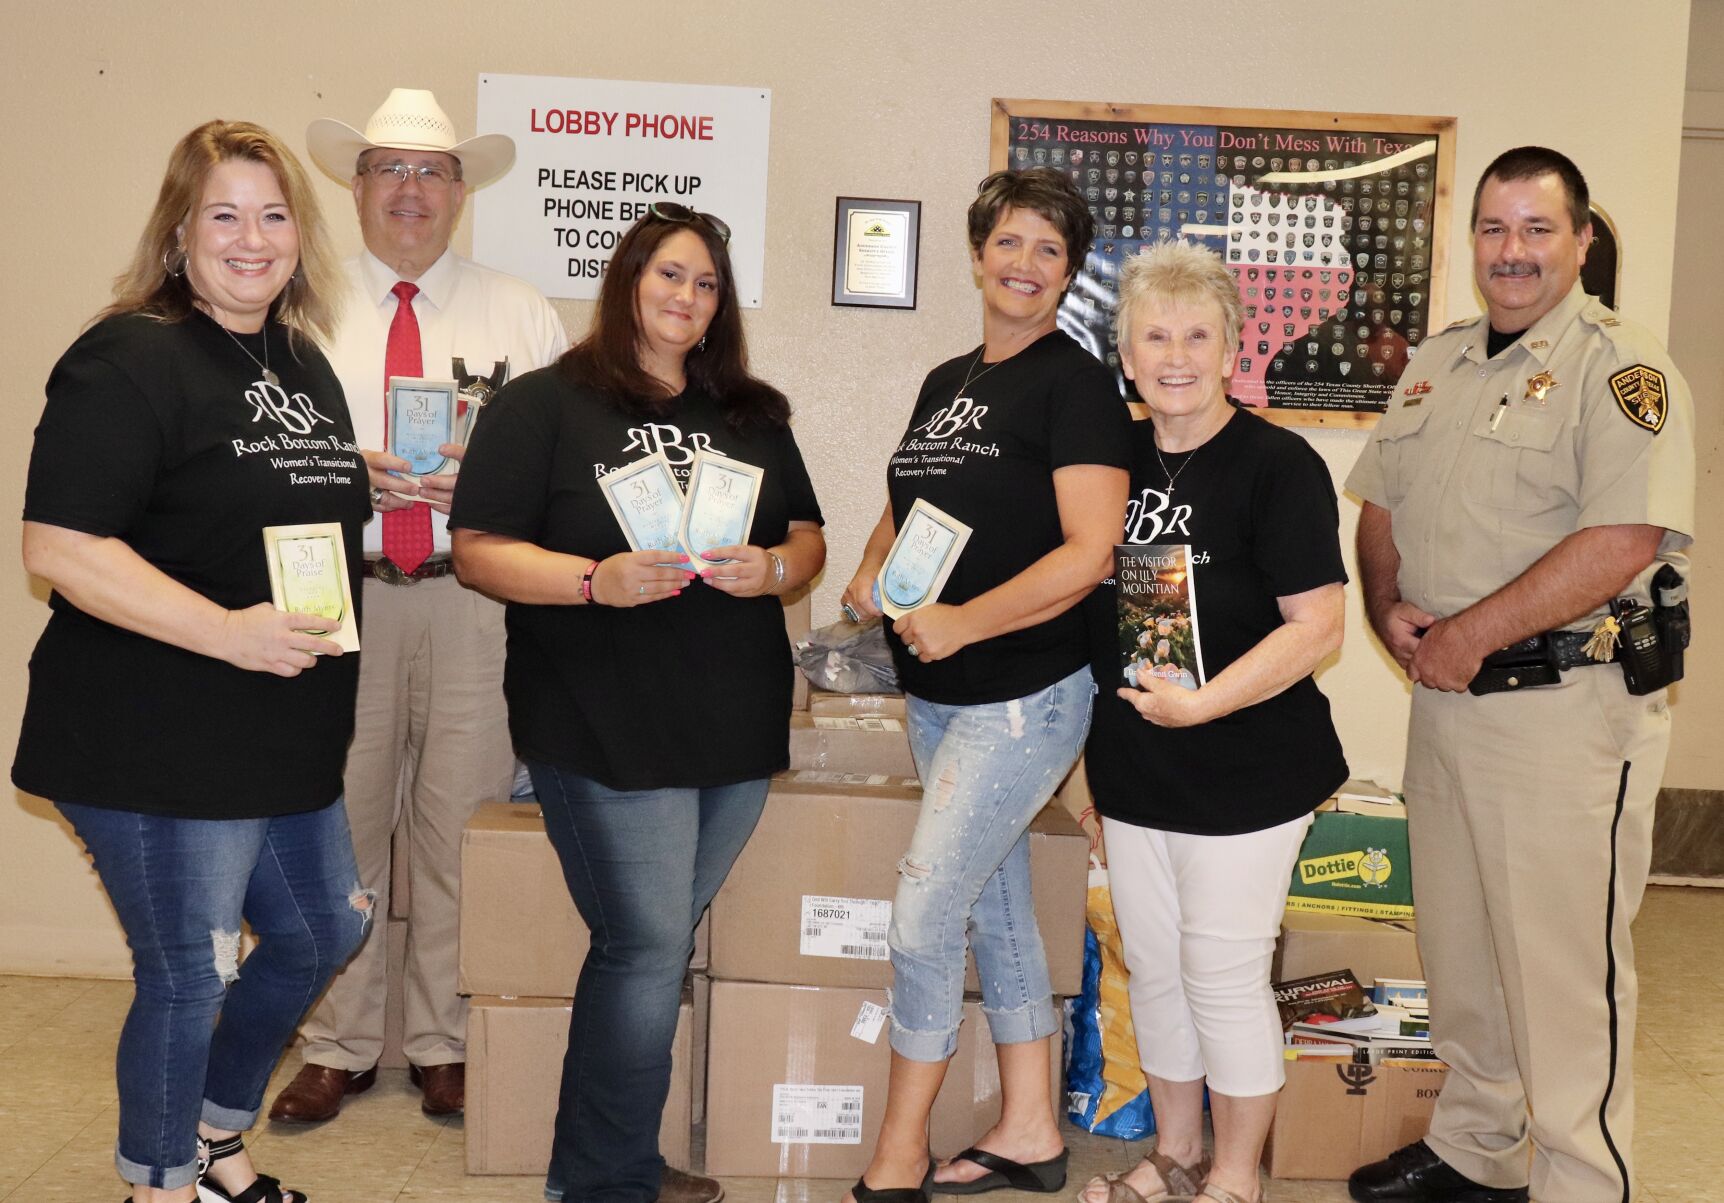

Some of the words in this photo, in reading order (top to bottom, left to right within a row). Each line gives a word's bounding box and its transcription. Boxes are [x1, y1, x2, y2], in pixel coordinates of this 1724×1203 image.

[530, 108, 619, 137] LOBBY
[625, 113, 714, 141] PHONE
[1018, 123, 1050, 141] 254
[1056, 125, 1128, 144] Reasons
[1133, 128, 1175, 150] Why
[1179, 130, 1215, 148] You
[1219, 131, 1270, 150] Don't
[1275, 134, 1320, 151] Mess
[1325, 136, 1367, 154] With
[1372, 138, 1414, 155] Tex
[538, 168, 617, 191] PLEASE
[622, 172, 669, 194] PICK
[674, 175, 702, 195] UP
[544, 198, 614, 220] PHONE
[554, 228, 581, 248] TO
[414, 395, 430, 412] 31
[406, 409, 428, 419] Days
[428, 410, 438, 418] of
[408, 416, 436, 426] Prayer
[231, 435, 280, 457] Rock
[277, 433, 331, 450] Bottom
[906, 438, 948, 451] Bottom
[950, 437, 1000, 458] Ranch
[270, 456, 314, 469] Women's
[313, 455, 358, 469] Transitional
[921, 454, 966, 465] Transitional
[593, 461, 634, 479] Ro
[895, 467, 925, 478] Recovery
[926, 466, 947, 475] Home
[289, 472, 328, 486] Recovery
[328, 472, 352, 485] Home
[717, 473, 733, 493] 31
[630, 480, 650, 499] 31
[630, 494, 653, 509] Days
[636, 498, 663, 514] Prayer
[920, 524, 937, 544] 31
[297, 544, 314, 562] 31
[1120, 556, 1136, 568] THE
[1137, 554, 1177, 568] VISITOR
[293, 561, 315, 570] Days
[315, 559, 325, 567] of
[296, 569, 324, 577] Praise
[1121, 569, 1137, 581] ON
[1139, 569, 1158, 584] LILY
[1121, 581, 1179, 597] MOUNTIAN
[1303, 858, 1356, 879] Dottie
[812, 908, 850, 920] 1687021
[1301, 903, 1336, 911] ANCHORS
[1341, 906, 1374, 914] FITTINGS
